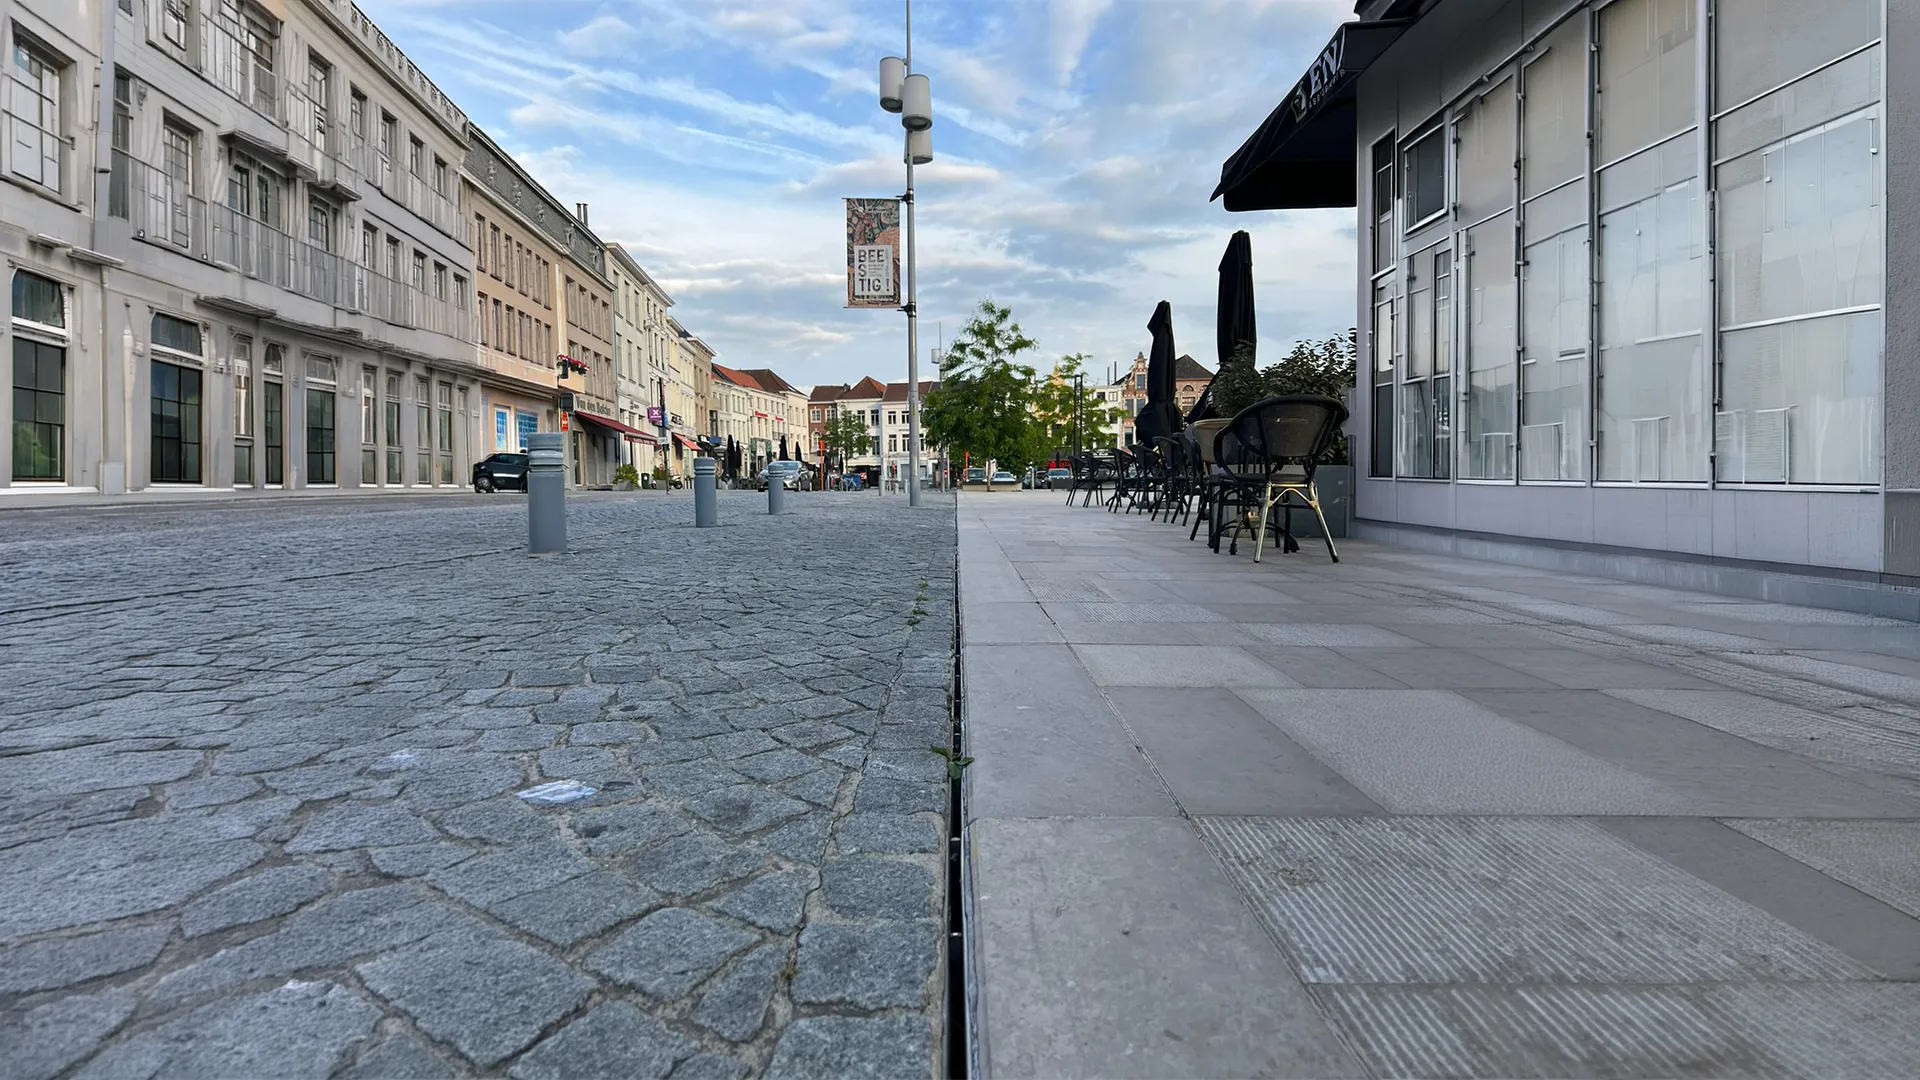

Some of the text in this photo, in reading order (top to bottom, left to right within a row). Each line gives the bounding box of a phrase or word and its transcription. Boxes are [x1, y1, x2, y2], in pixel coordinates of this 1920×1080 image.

[858, 249, 884, 263] BEE
[858, 264, 867, 277] S
[859, 278, 881, 292] TIG
